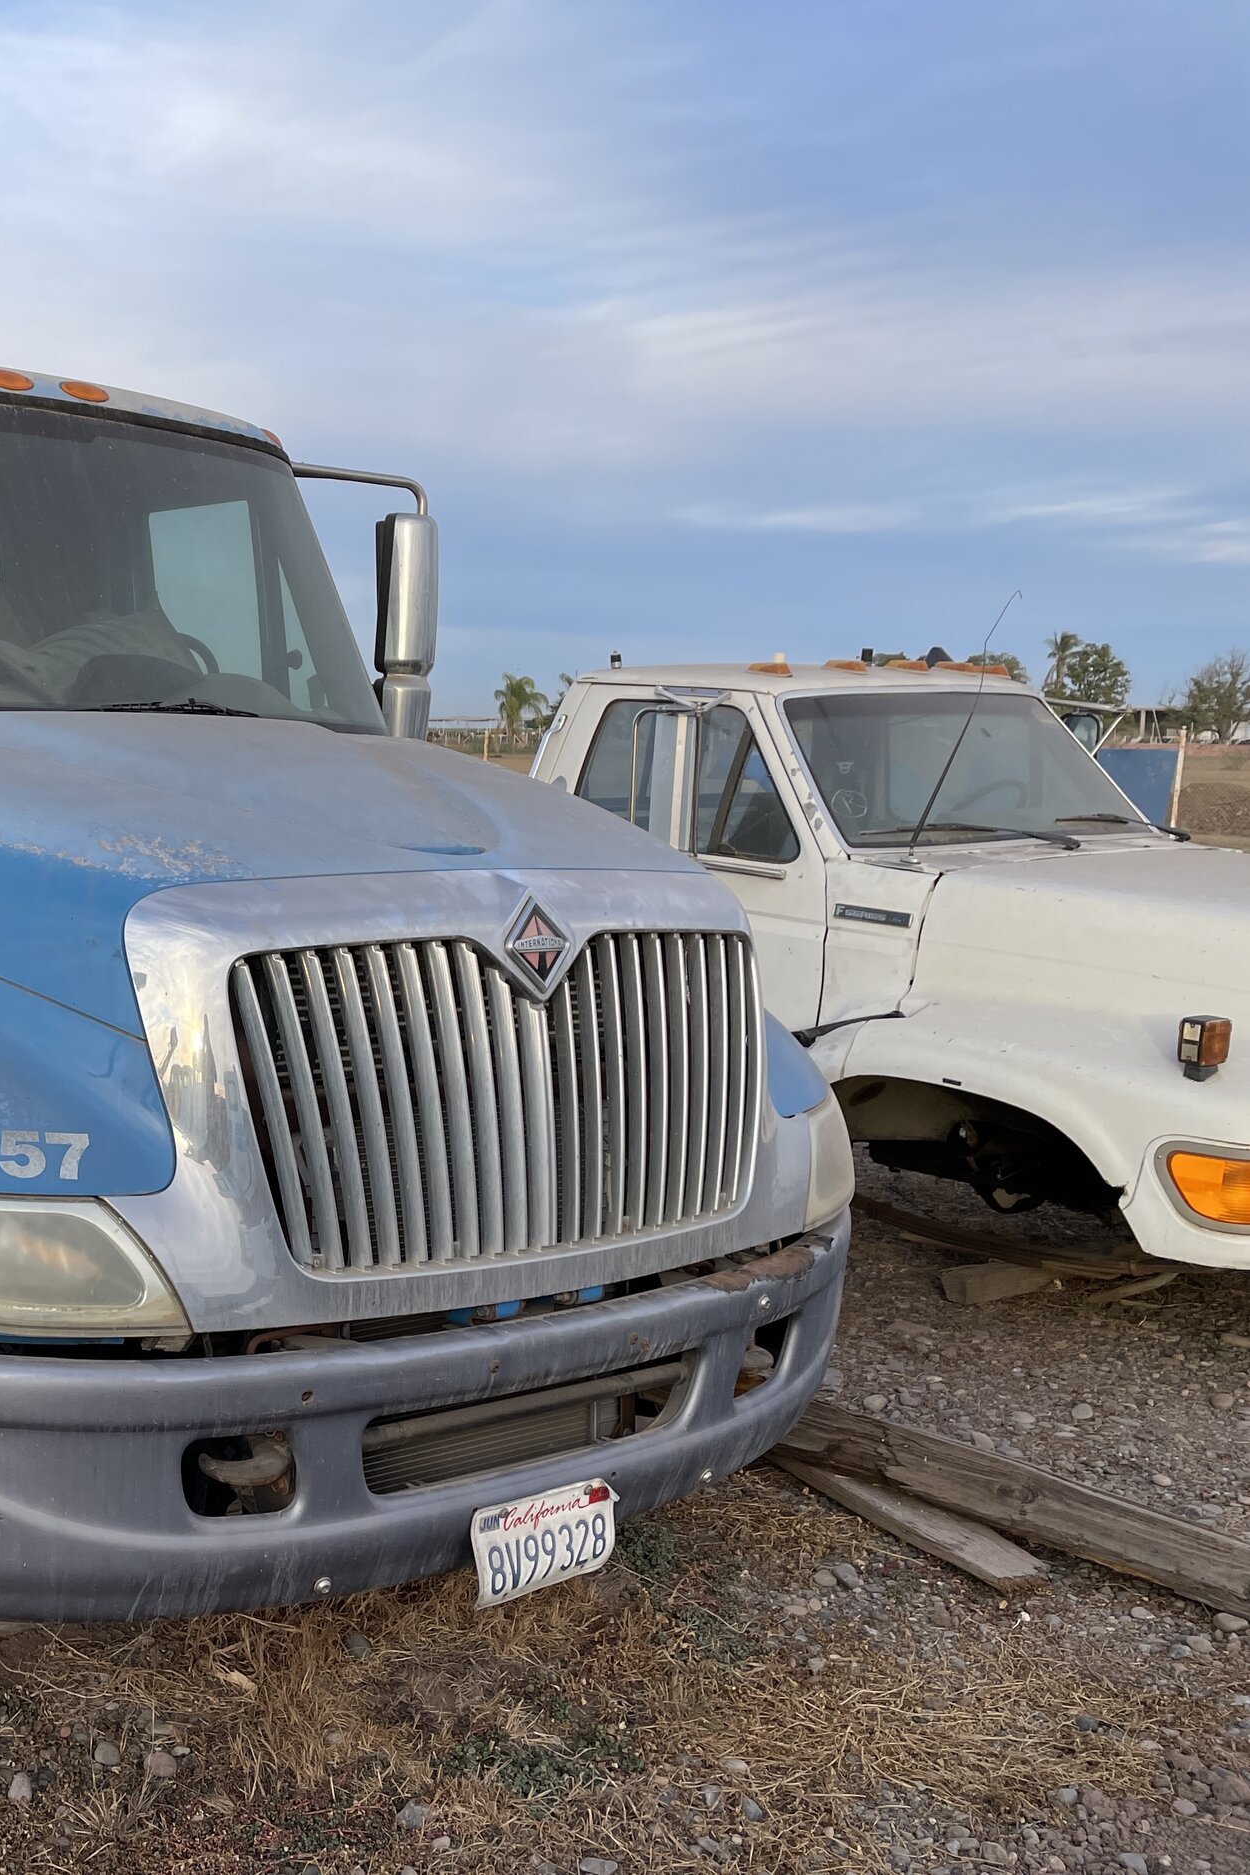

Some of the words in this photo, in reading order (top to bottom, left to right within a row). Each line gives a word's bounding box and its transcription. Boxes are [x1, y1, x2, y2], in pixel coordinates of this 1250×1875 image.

[835, 905, 846, 916] F
[480, 1515, 500, 1532] JUN
[503, 1497, 590, 1531] California
[488, 1513, 607, 1596] 8V99328
